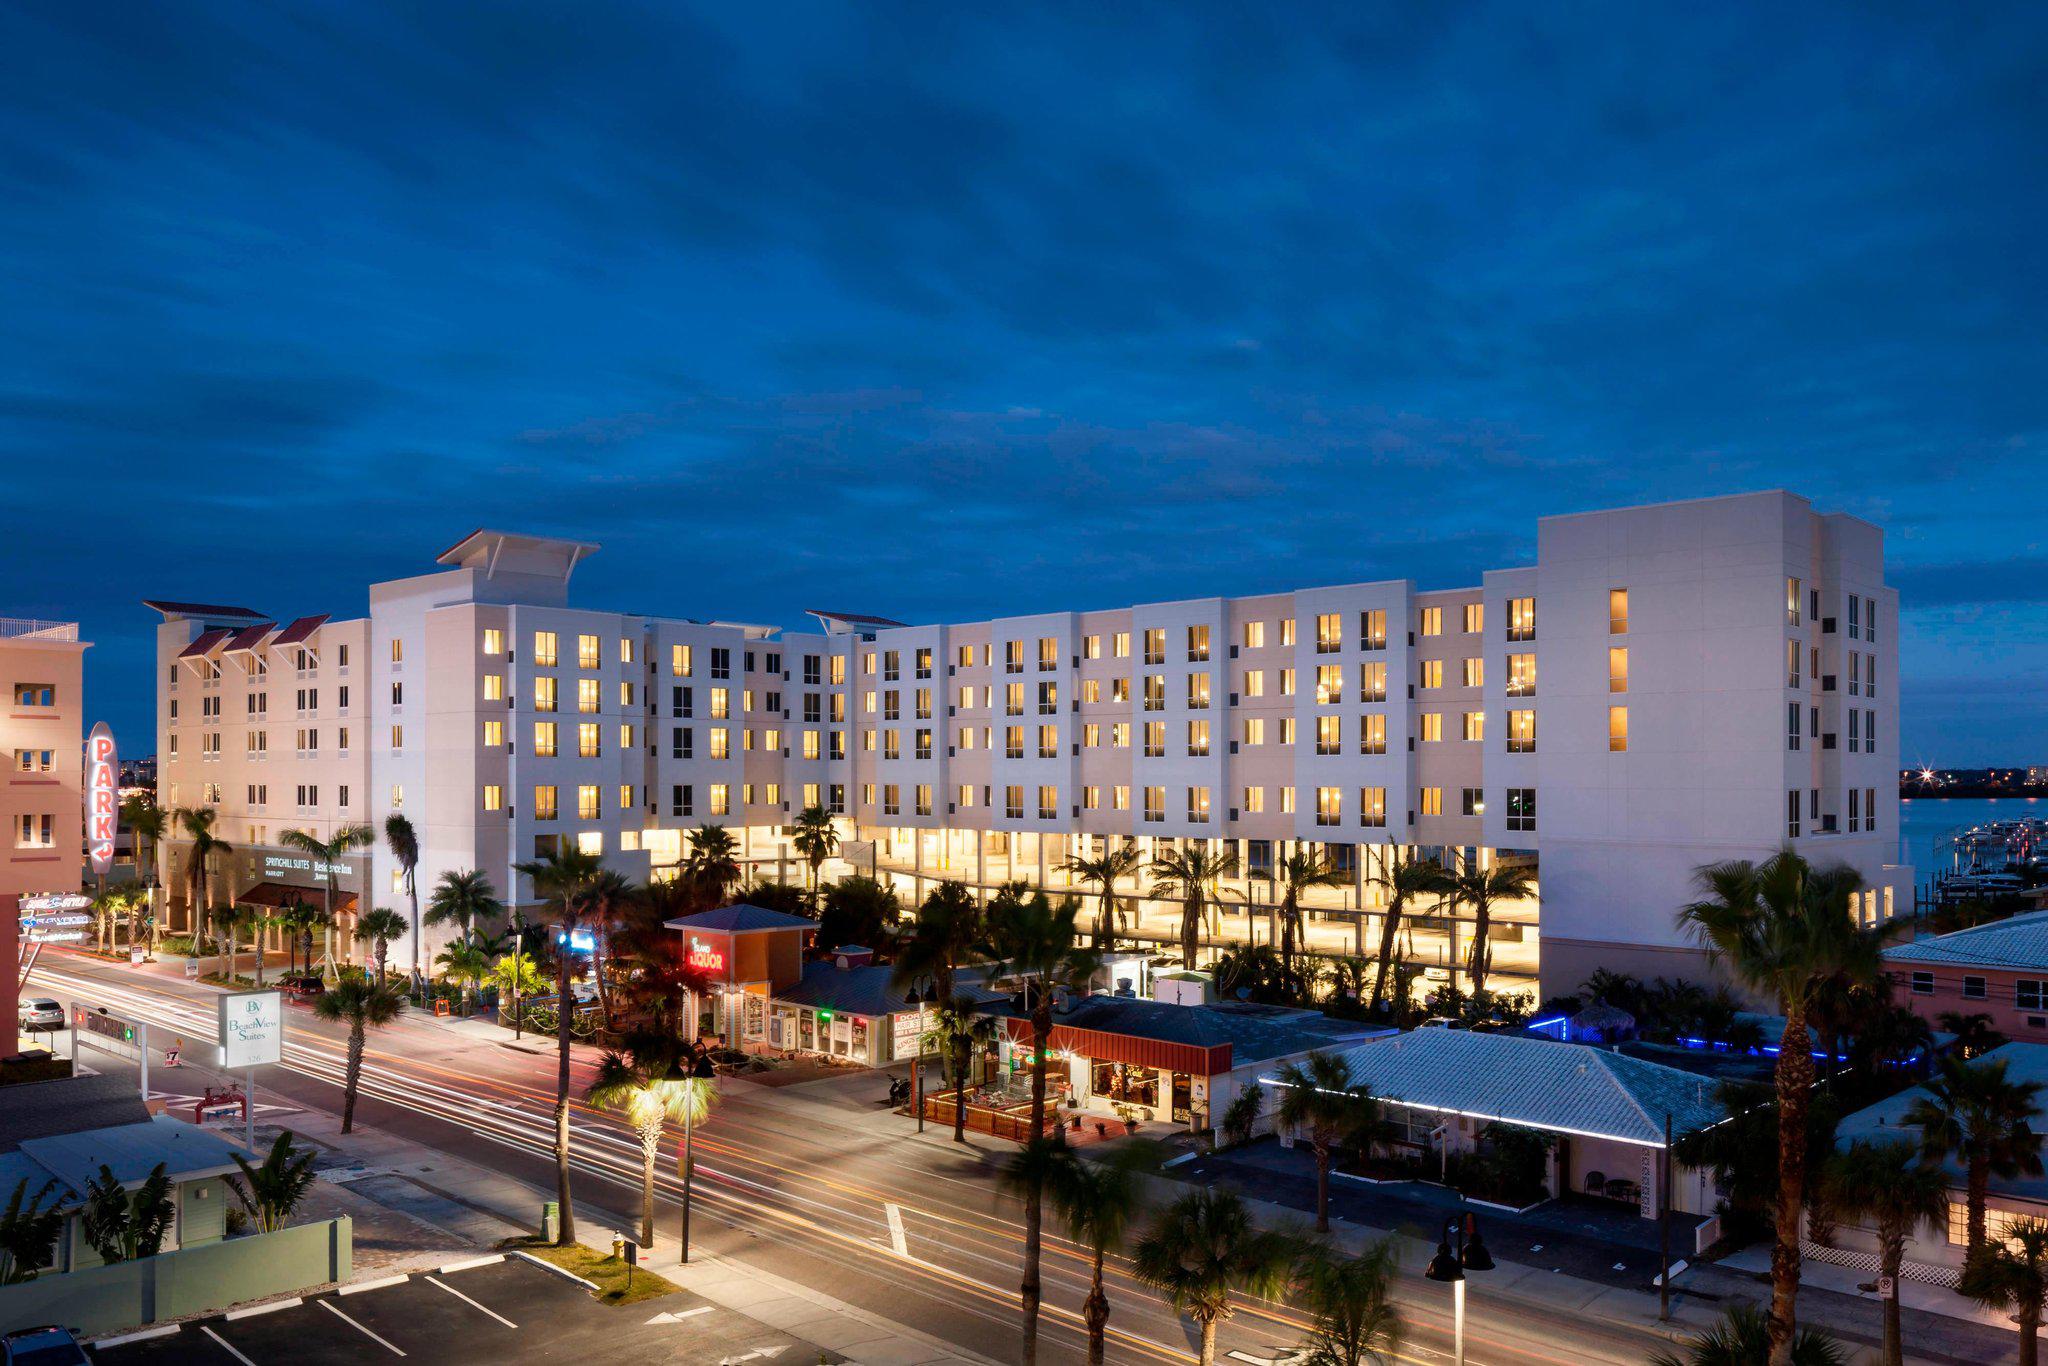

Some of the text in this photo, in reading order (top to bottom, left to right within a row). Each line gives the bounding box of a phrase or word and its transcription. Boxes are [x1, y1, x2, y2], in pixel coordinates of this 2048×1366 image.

[94, 737, 113, 840] PARK
[265, 857, 310, 870] SPRINGHILL SUITES
[341, 863, 352, 875] Inn
[690, 953, 723, 970] LIQUOR
